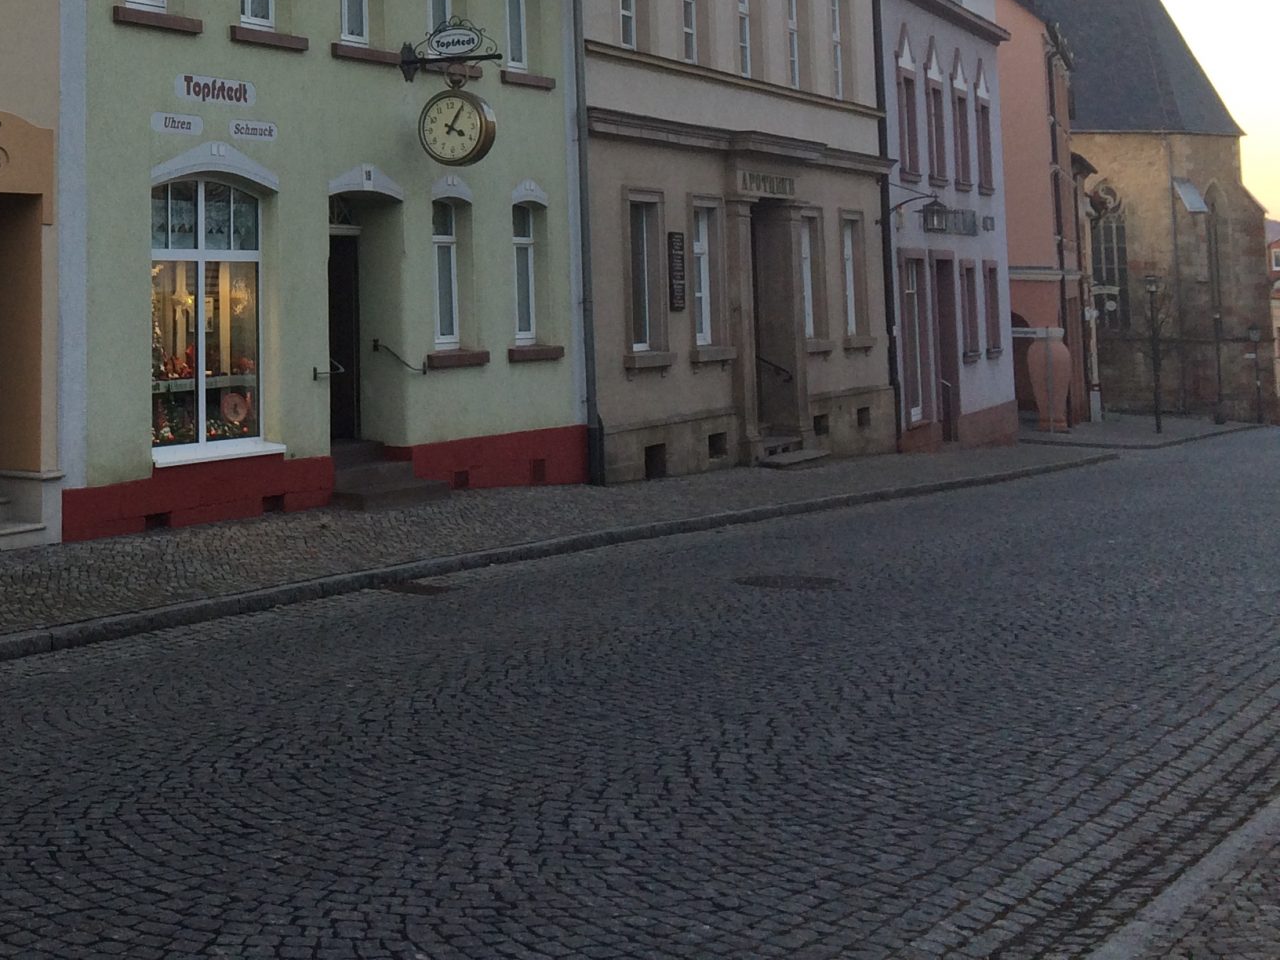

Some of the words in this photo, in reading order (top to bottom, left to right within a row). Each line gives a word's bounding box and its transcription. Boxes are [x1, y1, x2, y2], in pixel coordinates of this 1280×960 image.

[435, 37, 475, 49] Topfstedt
[184, 75, 248, 103] Topfstedt
[164, 116, 192, 130] Uhren
[234, 123, 273, 137] Schmuck
